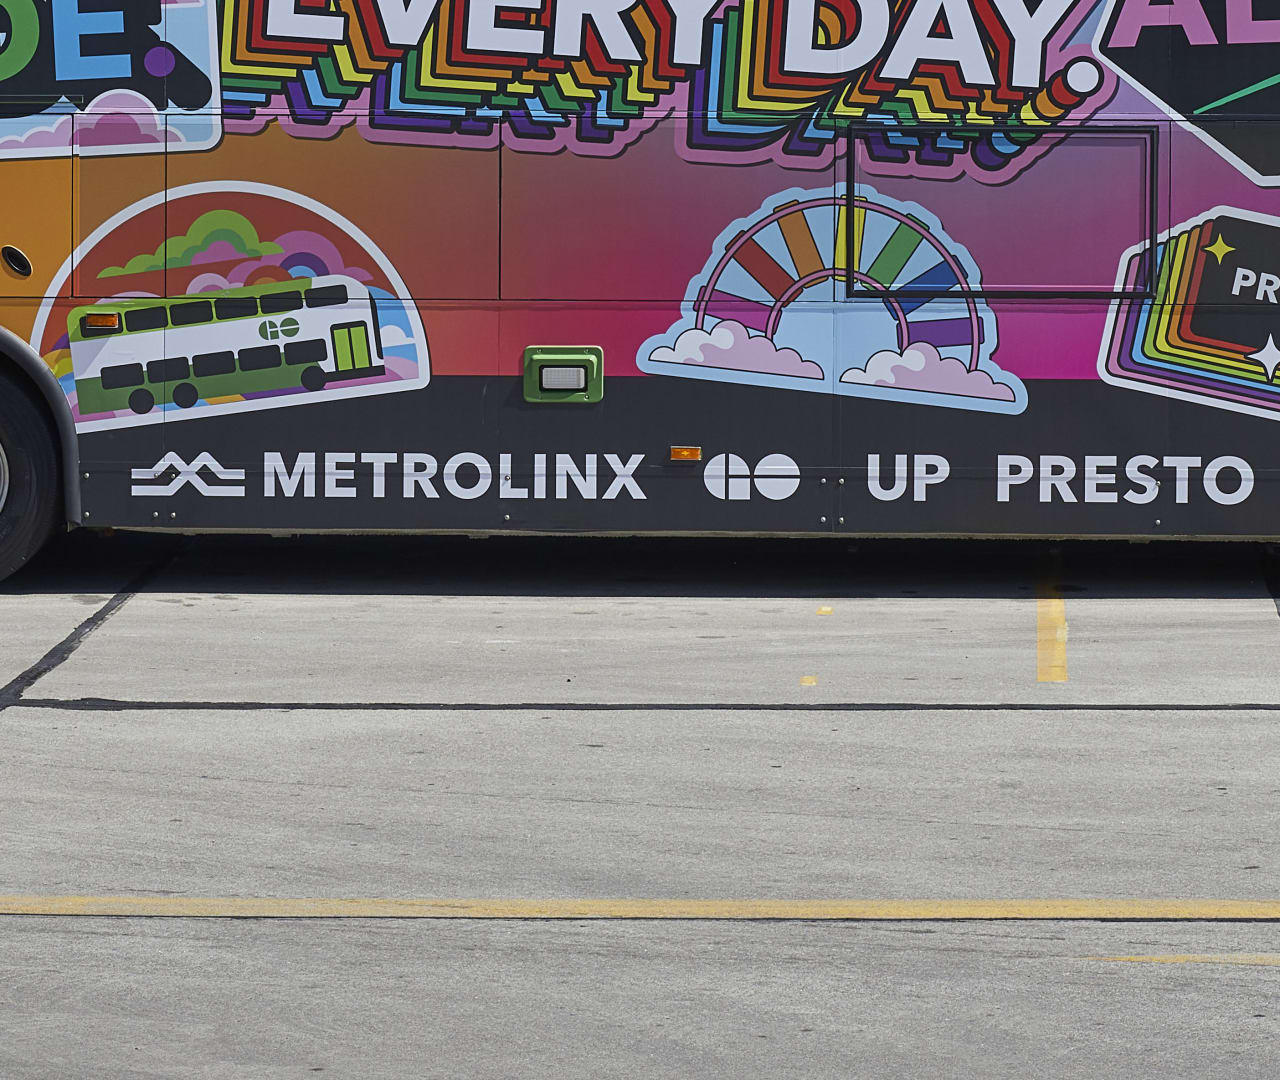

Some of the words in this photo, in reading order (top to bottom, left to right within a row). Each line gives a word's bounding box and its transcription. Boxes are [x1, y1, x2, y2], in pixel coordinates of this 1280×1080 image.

[258, 317, 300, 341] GO
[264, 451, 646, 499] METROLINX
[703, 453, 800, 500] GO
[867, 454, 951, 503] UP
[997, 454, 1254, 505] PRESTO
